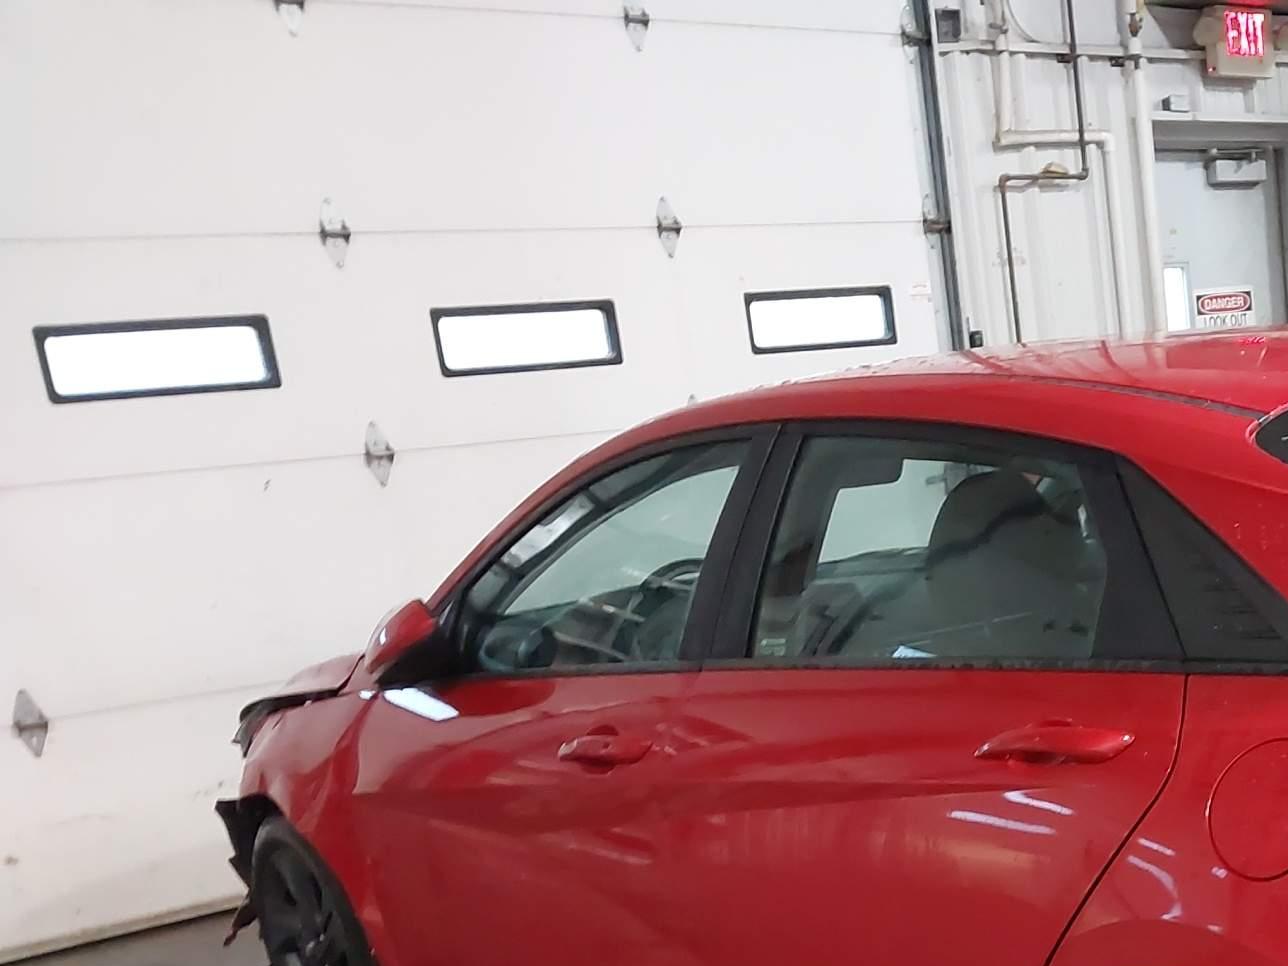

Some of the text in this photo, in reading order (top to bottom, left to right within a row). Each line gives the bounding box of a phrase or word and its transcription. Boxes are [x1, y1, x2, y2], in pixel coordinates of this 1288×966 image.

[1224, 11, 1265, 56] EXIT
[1204, 296, 1245, 310] DANGER
[1230, 313, 1248, 327] OUT
